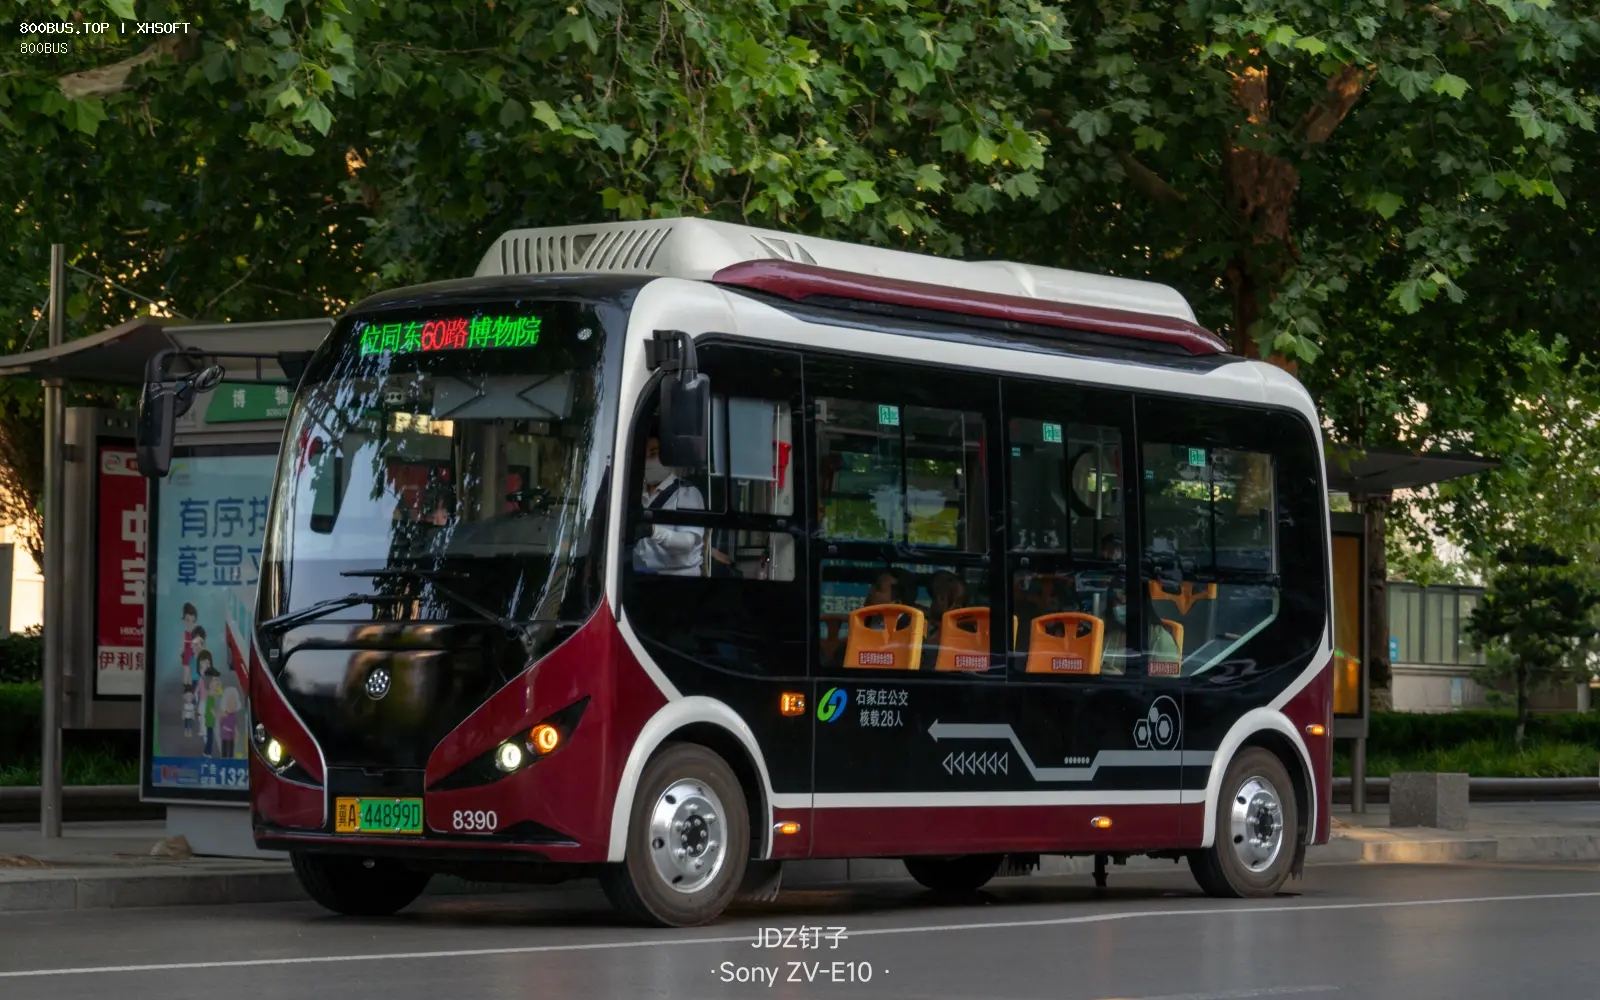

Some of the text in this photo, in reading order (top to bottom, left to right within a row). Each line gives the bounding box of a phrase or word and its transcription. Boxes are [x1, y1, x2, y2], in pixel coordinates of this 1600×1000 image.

[856, 688, 908, 707] 石家庄公交
[860, 710, 904, 728] 核载28人
[219, 766, 249, 786] 132
[452, 810, 498, 830] 8390
